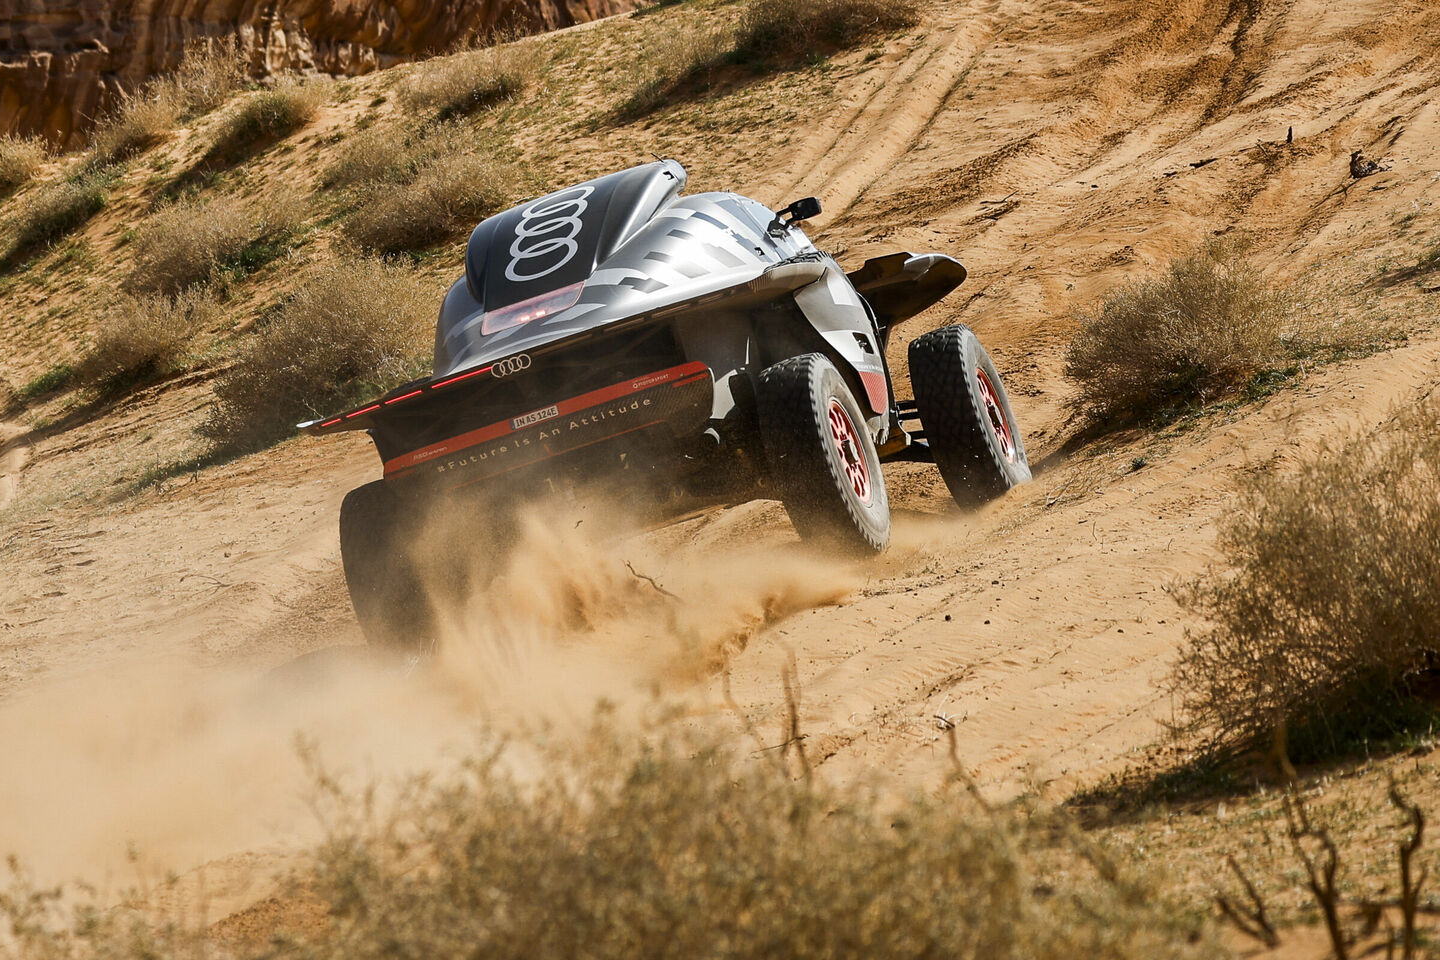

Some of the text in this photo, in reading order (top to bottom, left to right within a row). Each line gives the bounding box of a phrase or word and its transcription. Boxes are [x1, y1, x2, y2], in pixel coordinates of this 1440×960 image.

[437, 445, 508, 473] #Future
[514, 438, 530, 448] Is
[539, 428, 560, 440] An
[569, 399, 651, 430] Attitude
[515, 407, 557, 427] IN AS 124E
